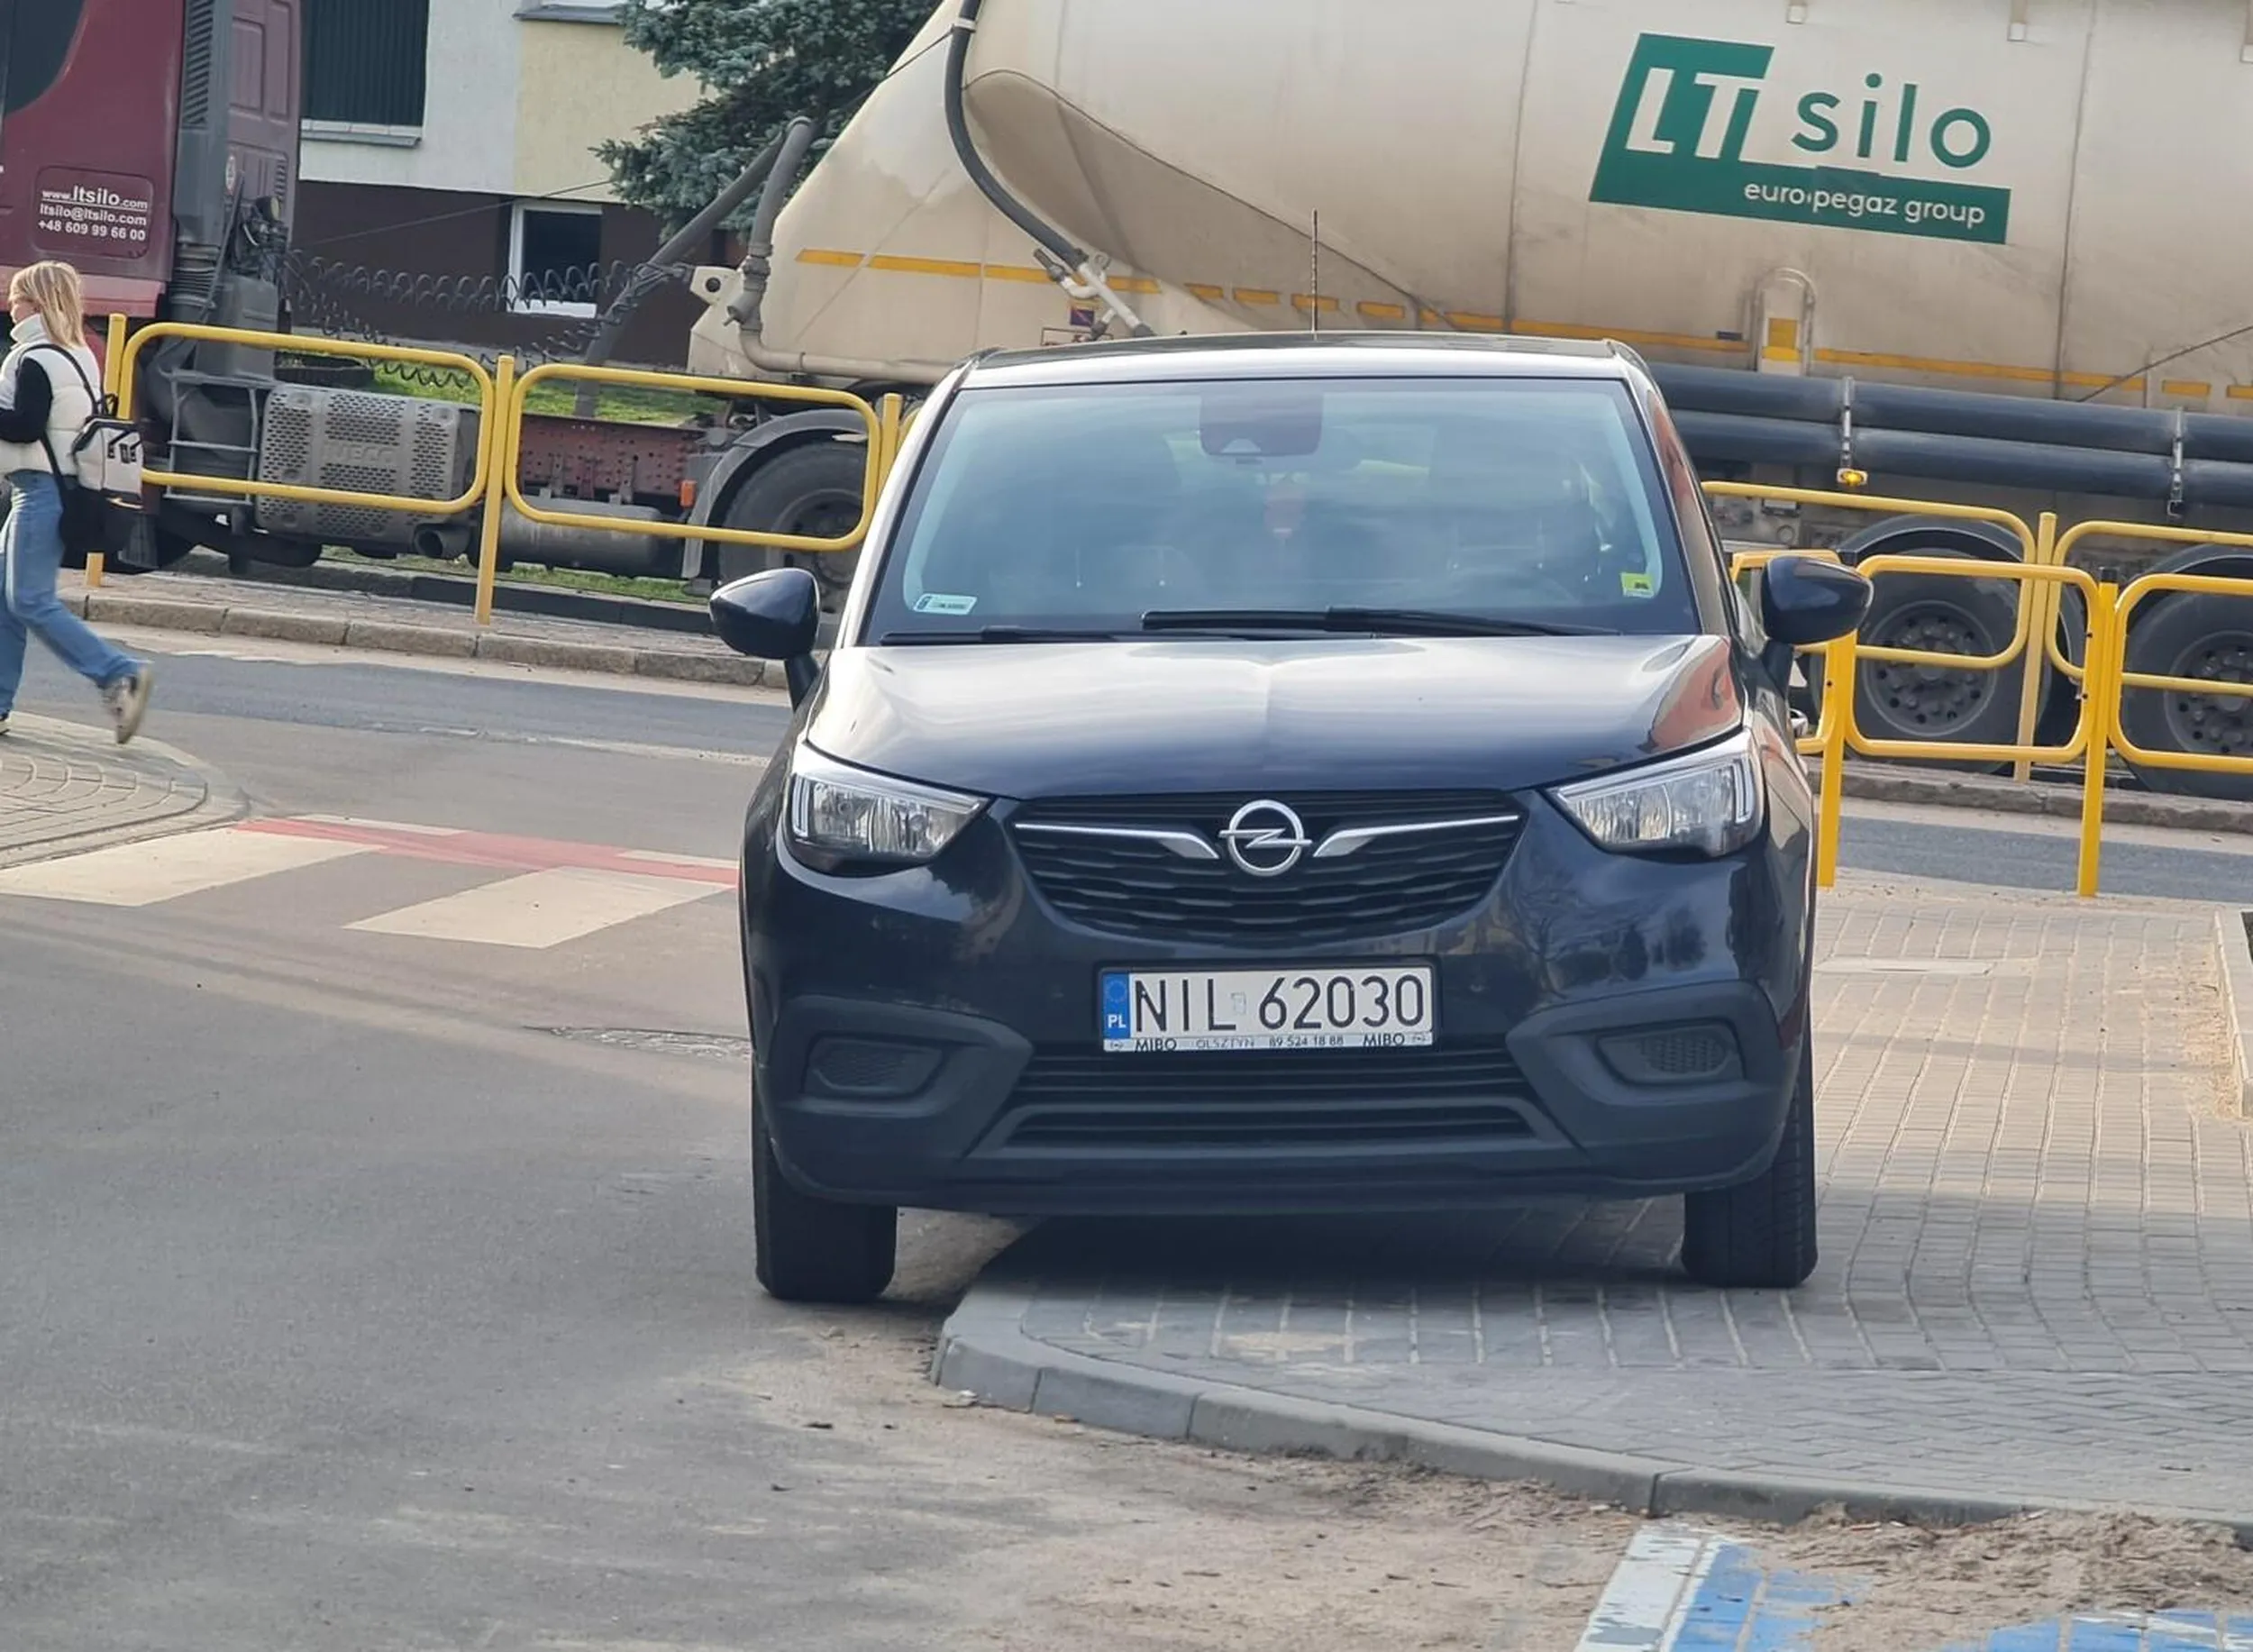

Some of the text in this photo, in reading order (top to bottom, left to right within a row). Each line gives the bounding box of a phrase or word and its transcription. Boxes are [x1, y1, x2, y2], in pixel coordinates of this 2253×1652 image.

[1625, 67, 1992, 169] LT silo
[41, 185, 149, 210] www.ltsilo.com
[40, 203, 147, 226] ltsilo@ltsilo.com
[1903, 199, 1985, 229] group
[38, 219, 62, 232] +48
[65, 222, 88, 235] 609
[92, 224, 107, 237] 99
[130, 229, 146, 241] 00
[1135, 973, 1425, 1032] NIL 62030
[1108, 1014, 1126, 1028] PL
[1135, 1037, 1177, 1053] MIBO
[1363, 1032, 1405, 1046] MIBO
